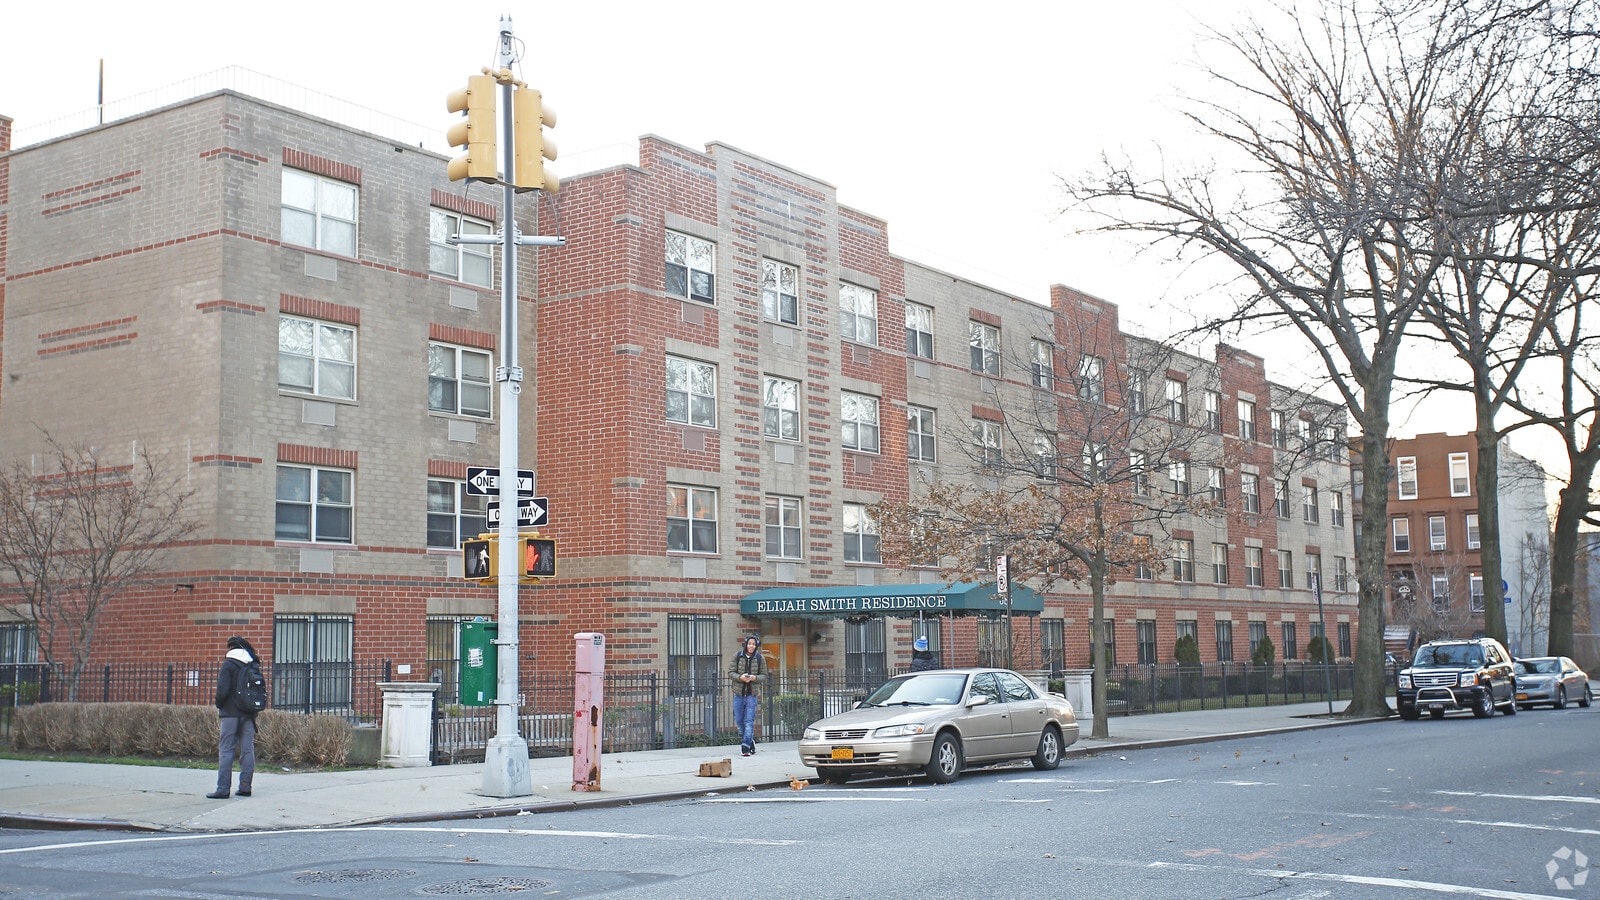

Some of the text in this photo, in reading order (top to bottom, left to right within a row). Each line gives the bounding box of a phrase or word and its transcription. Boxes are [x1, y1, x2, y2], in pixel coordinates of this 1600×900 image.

[476, 476, 495, 487] ONE
[520, 507, 539, 518] WAY
[757, 595, 947, 612] ELIJAH SMITH RESIDENCE
